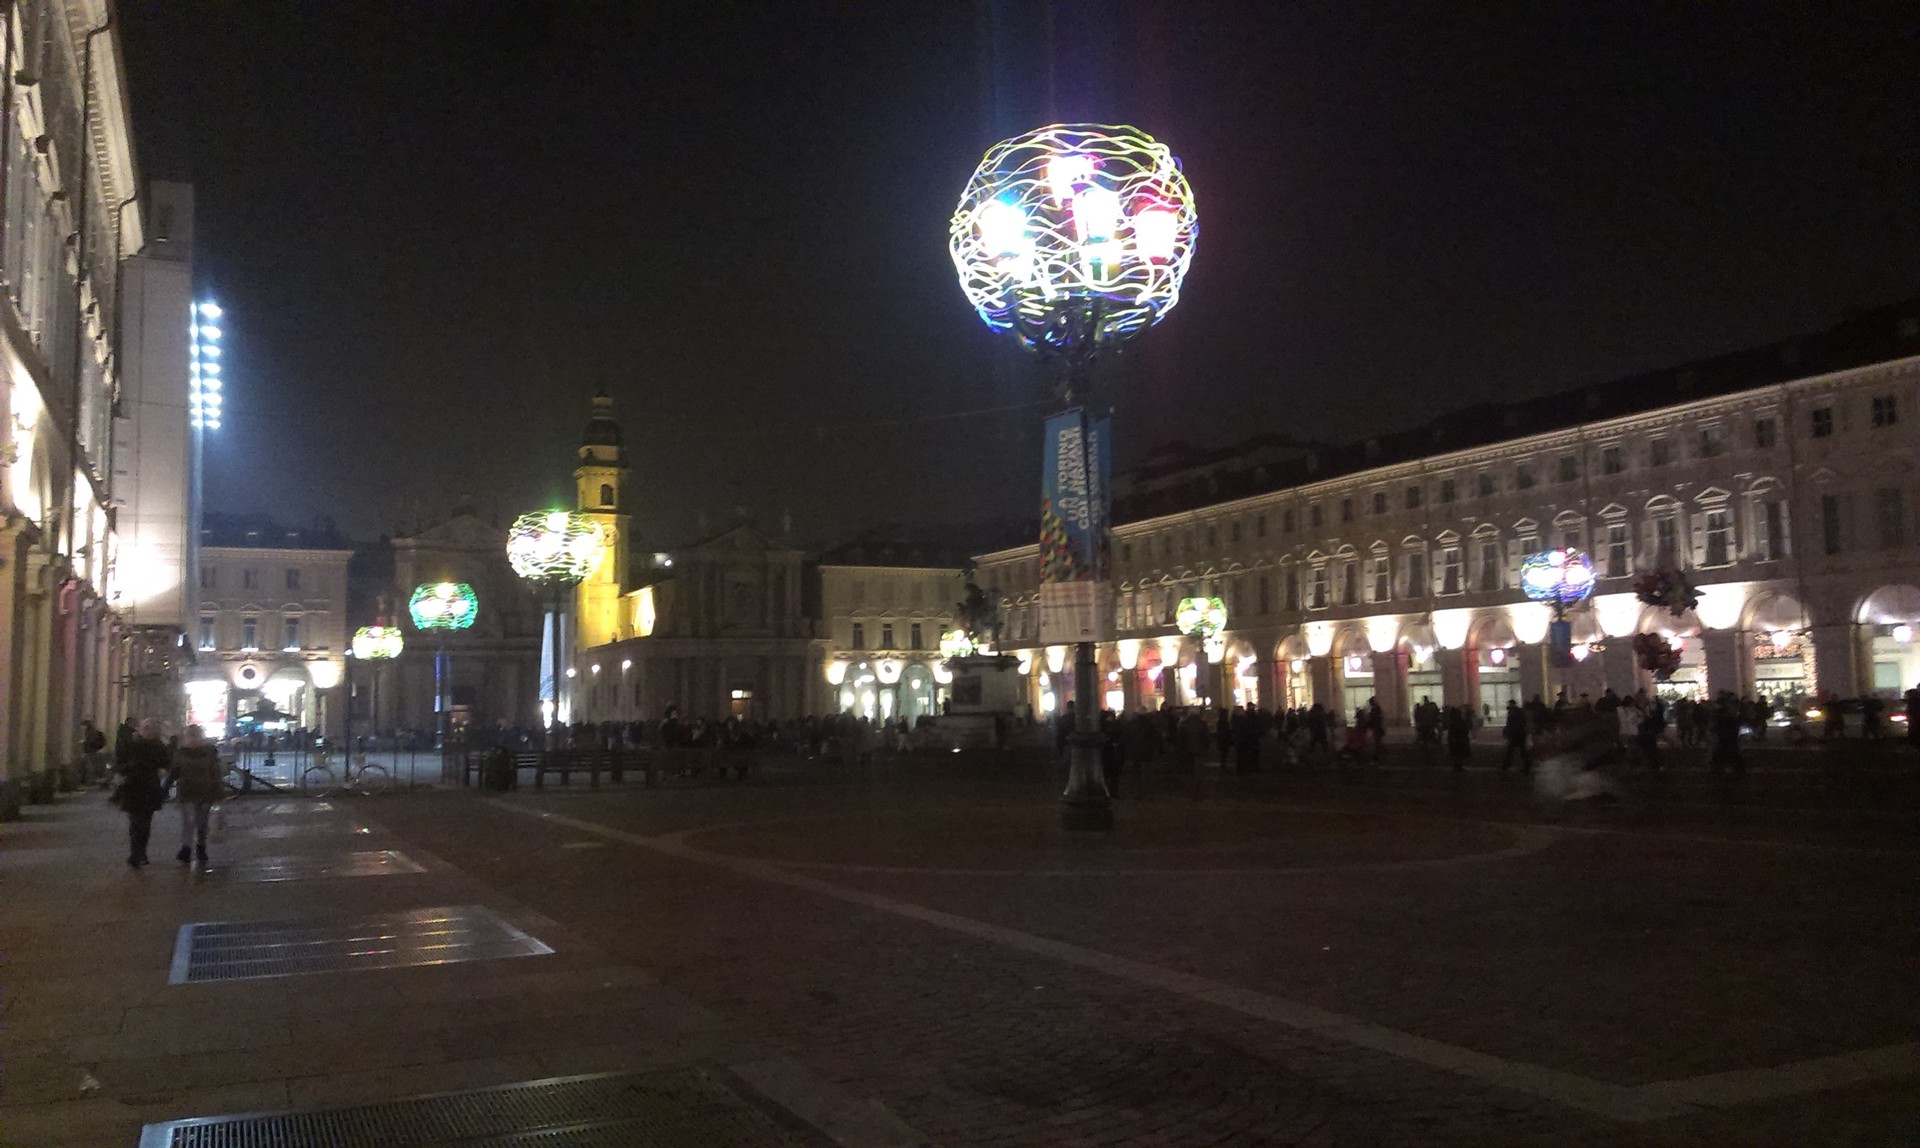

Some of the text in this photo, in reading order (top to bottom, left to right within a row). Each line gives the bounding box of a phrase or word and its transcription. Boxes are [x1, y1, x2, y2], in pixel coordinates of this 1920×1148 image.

[1058, 429, 1068, 509] A TORINO
[1067, 497, 1079, 521] UN
